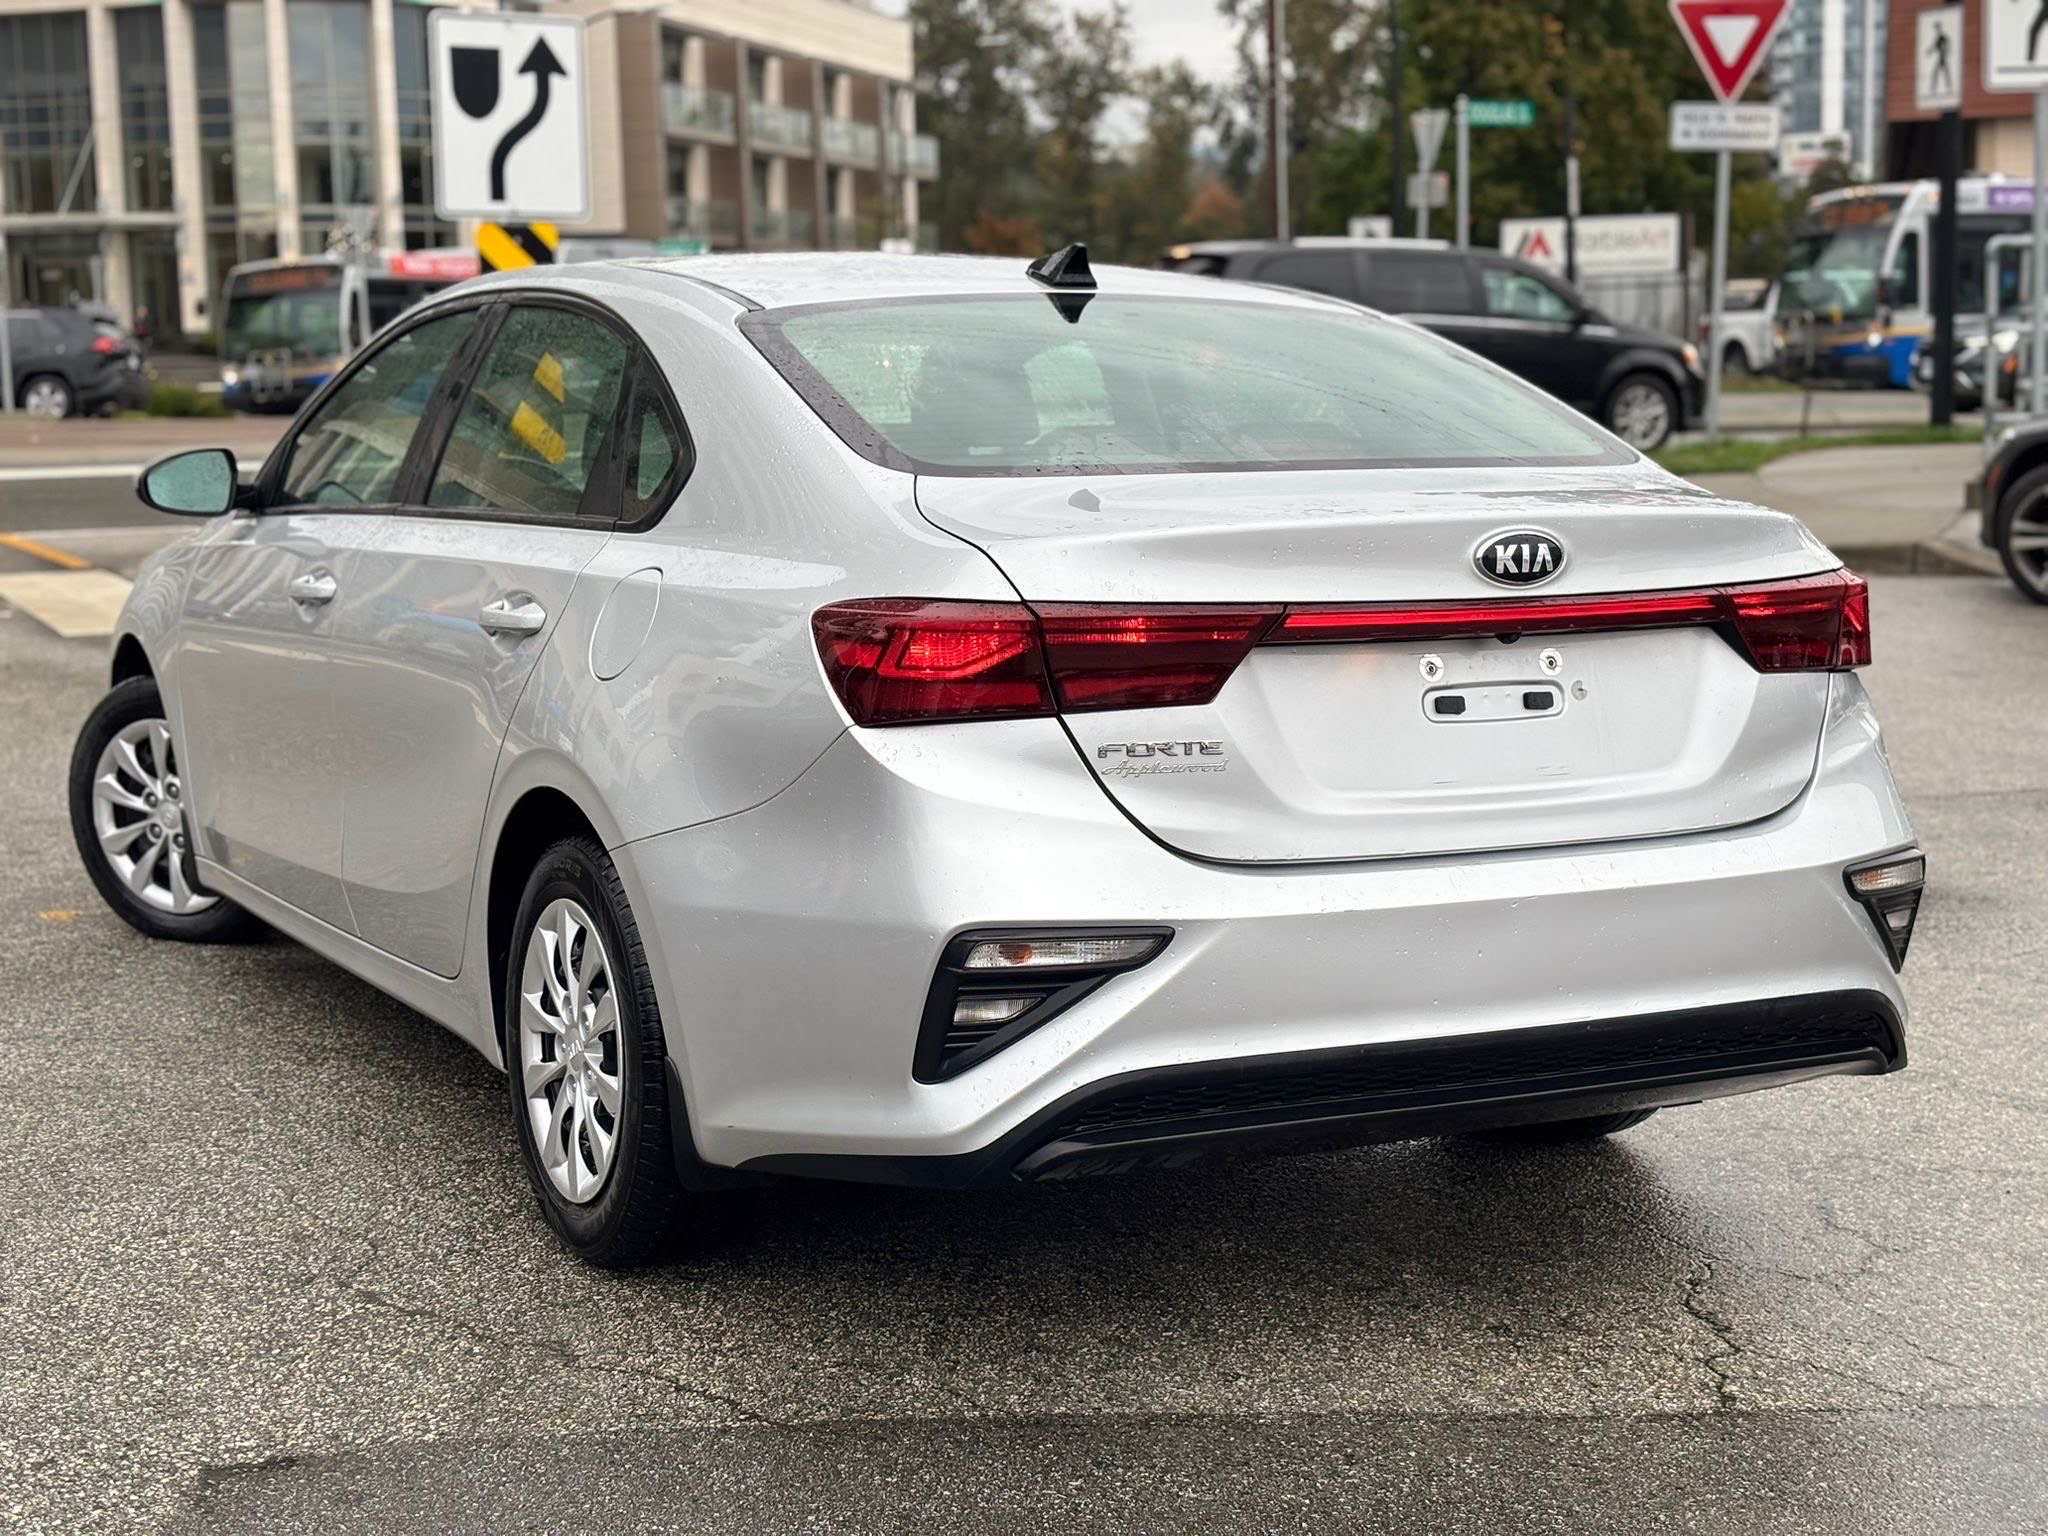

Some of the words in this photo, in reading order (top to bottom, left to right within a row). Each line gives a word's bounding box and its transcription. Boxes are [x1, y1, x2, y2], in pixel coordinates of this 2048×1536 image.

[1495, 543, 1553, 573] KIA
[1098, 740, 1223, 758] FORTE
[1101, 759, 1229, 778] Applewood
